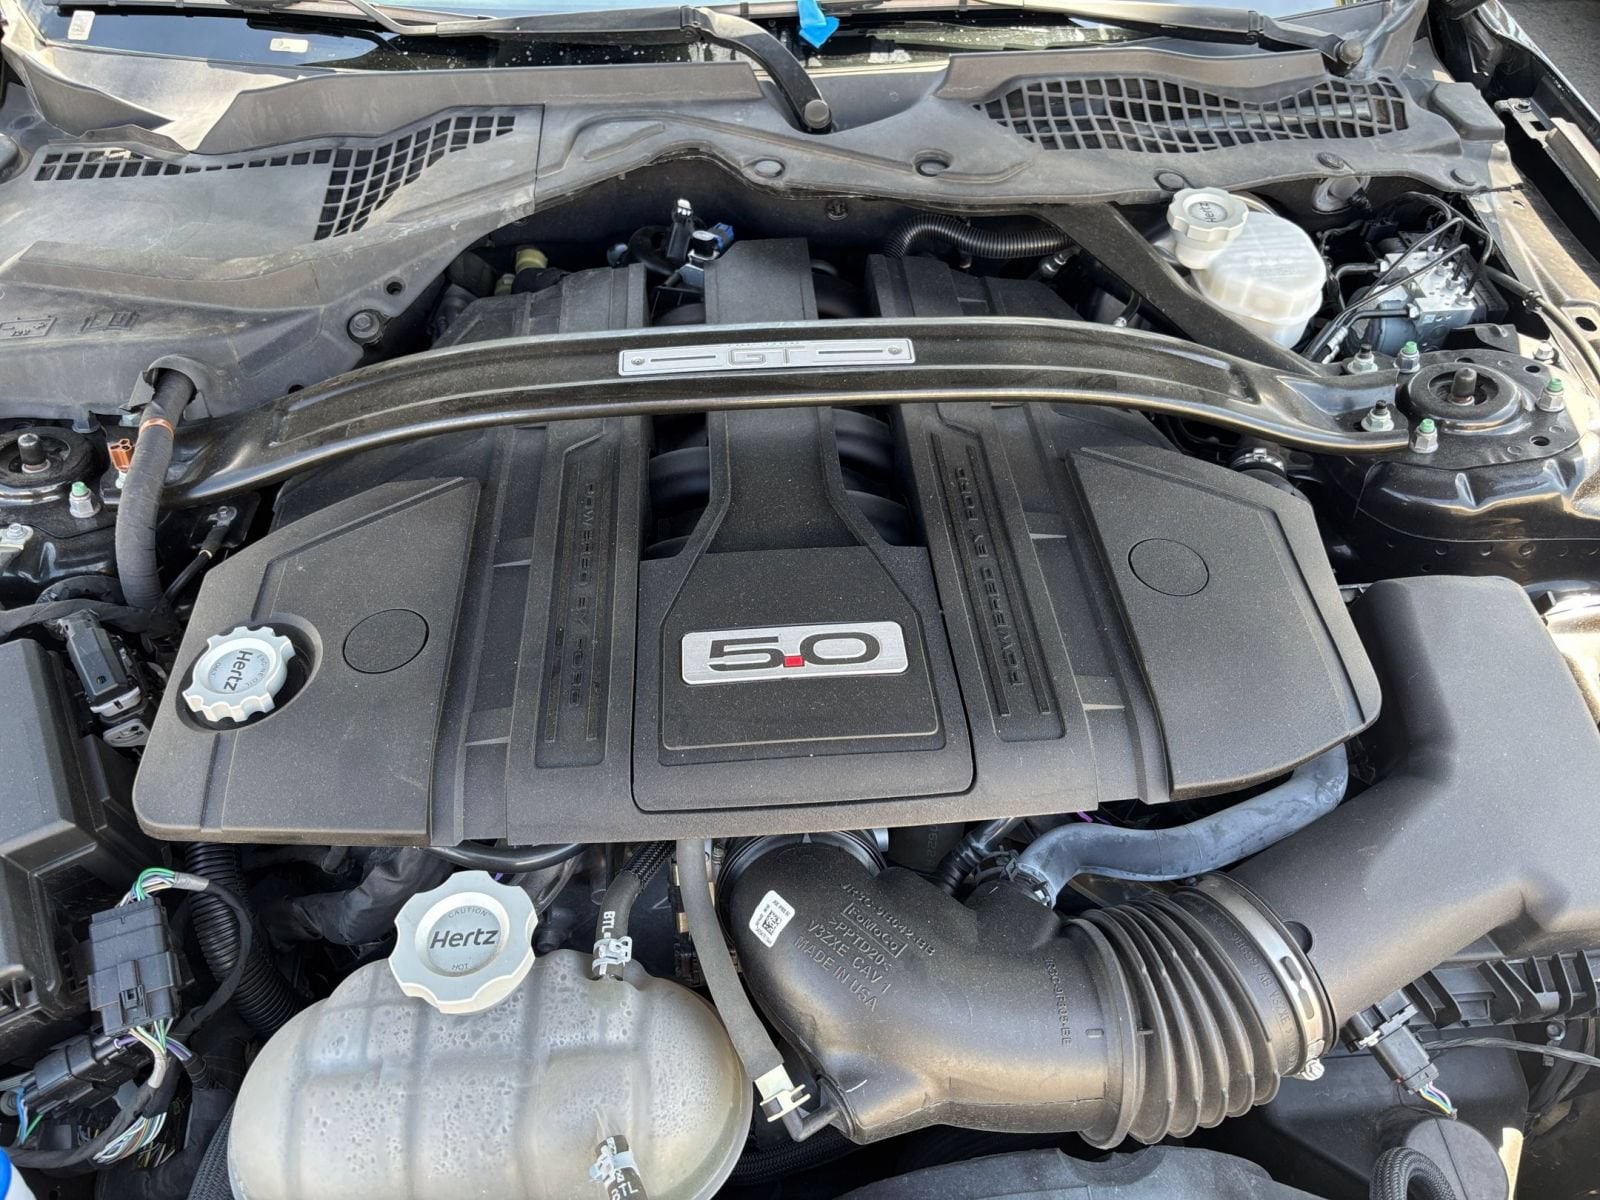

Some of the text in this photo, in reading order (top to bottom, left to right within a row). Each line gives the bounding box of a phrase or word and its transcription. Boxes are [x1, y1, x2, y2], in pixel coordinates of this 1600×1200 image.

[1199, 202, 1217, 223] Hertz
[727, 345, 805, 366] GT
[955, 467, 1024, 685] POWERED BY FORD
[708, 631, 881, 672] 5.0
[223, 650, 253, 691] Hertz
[448, 907, 488, 919] CAUTION
[602, 910, 616, 934] BTL
[430, 928, 499, 949] Hertz
[848, 907, 898, 951] FoMoCo
[451, 963, 469, 971] HOT
[794, 936, 835, 971] MADE
[833, 966, 850, 984] IN
[850, 979, 879, 1012] USA
[853, 956, 883, 984] CAV
